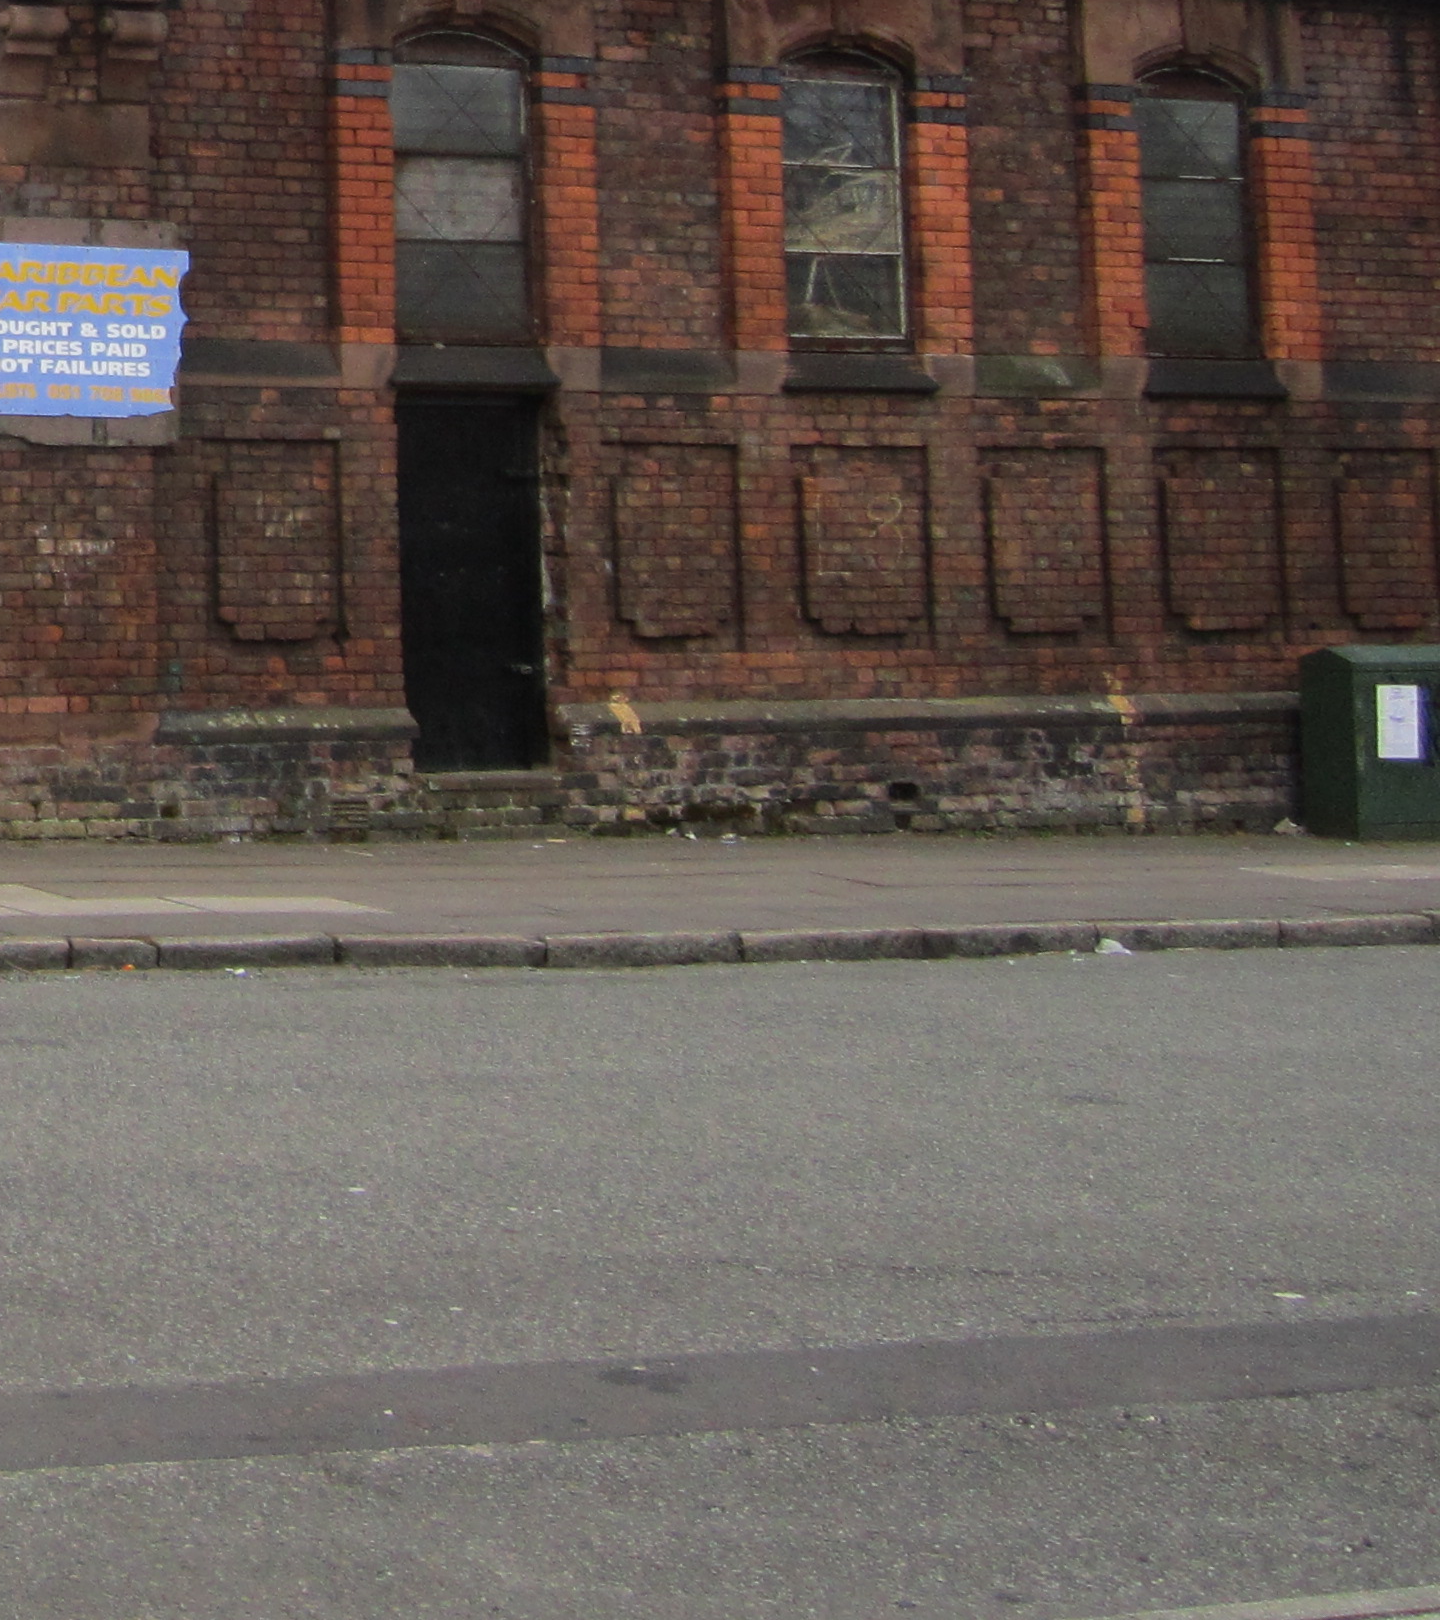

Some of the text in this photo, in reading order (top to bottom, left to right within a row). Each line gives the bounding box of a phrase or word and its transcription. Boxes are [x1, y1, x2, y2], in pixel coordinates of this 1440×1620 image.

[56, 291, 173, 317] PARTS
[80, 322, 99, 338] &
[107, 323, 166, 340] SOLD
[3, 339, 82, 356] PRICES
[91, 342, 147, 358] PAID
[40, 359, 151, 378] FAILURES
